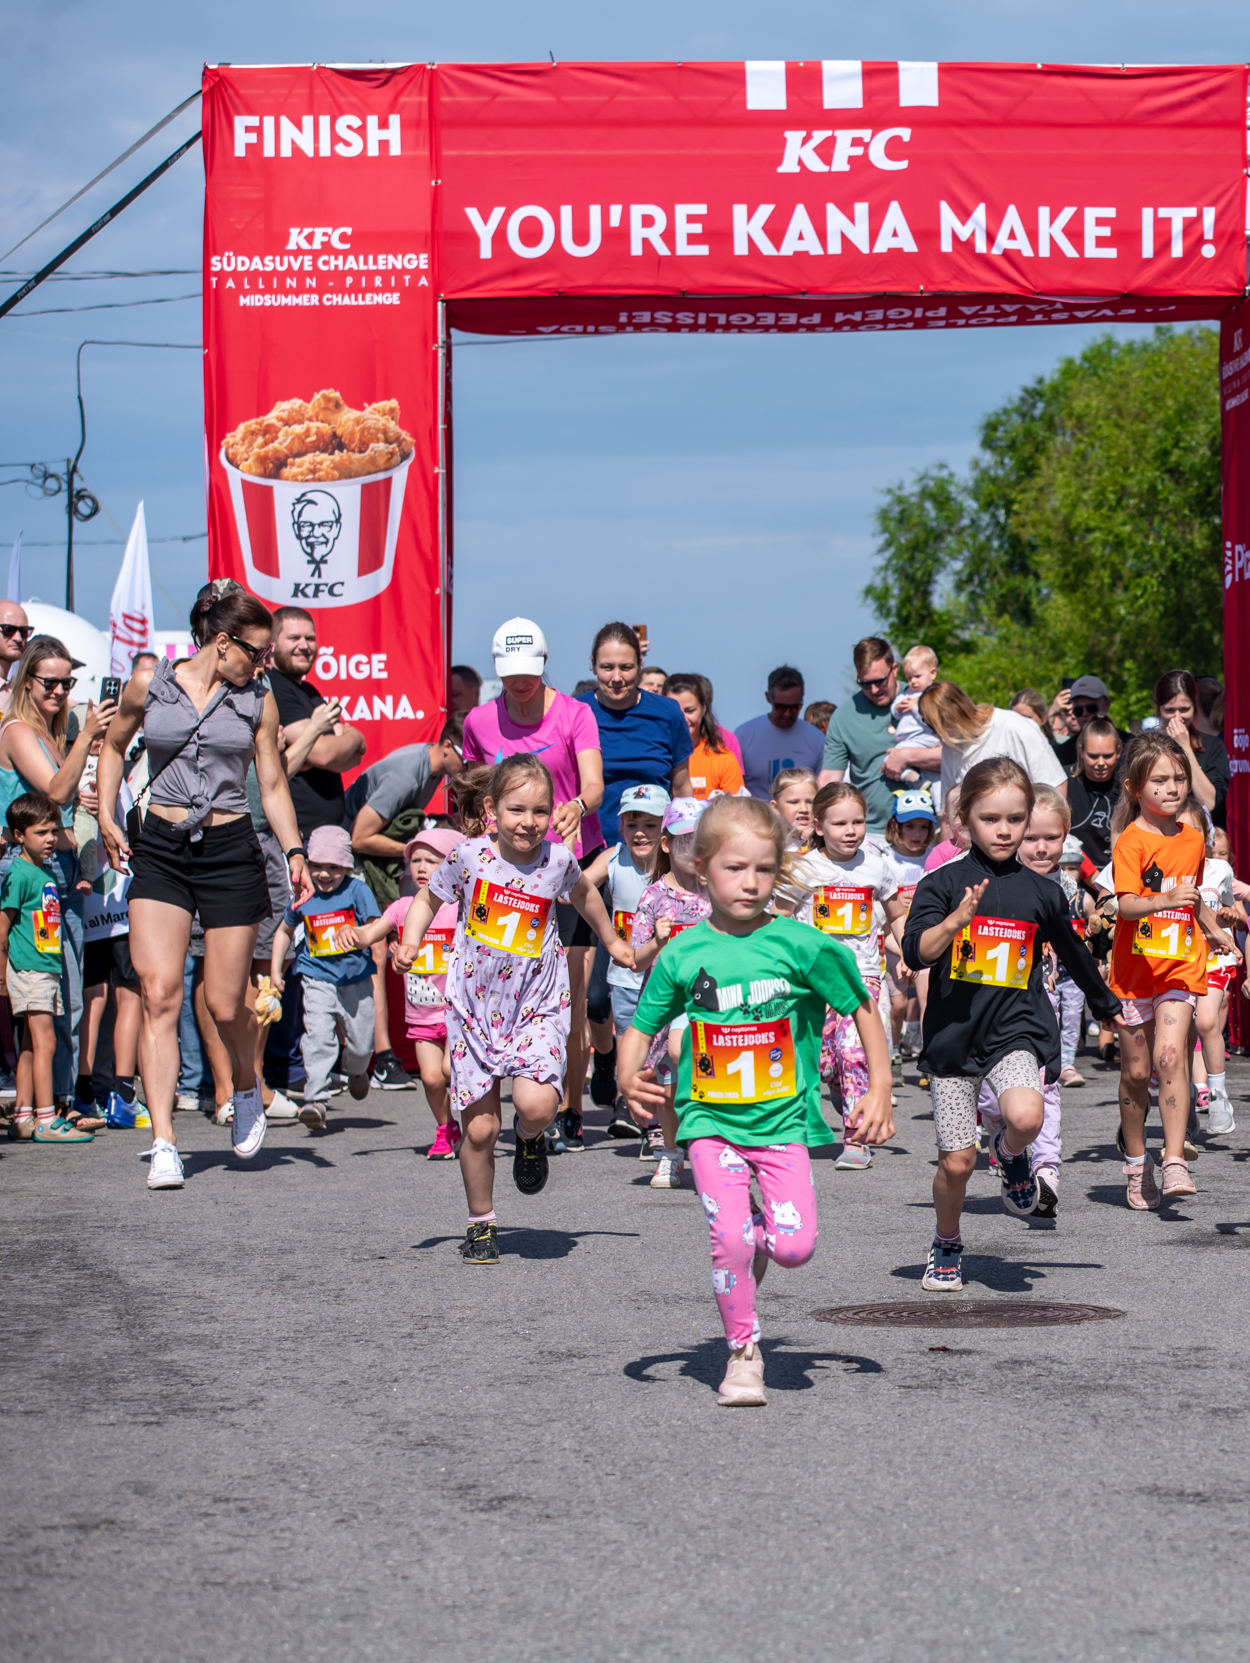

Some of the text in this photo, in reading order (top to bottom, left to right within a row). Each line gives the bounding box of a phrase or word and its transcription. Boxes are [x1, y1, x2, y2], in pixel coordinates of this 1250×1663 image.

[233, 114, 402, 158] FINISH
[776, 126, 912, 173] KFC
[286, 227, 352, 250] KFC
[463, 200, 1216, 259] YOU'RE KANA MAKE IT!
[210, 251, 429, 272] SÜDASUVE CHALLENGE
[210, 277, 317, 289] TALLINN
[346, 275, 429, 288] PIRITA
[239, 292, 401, 307] MIDSUMMER CHALLENGE
[618, 311, 822, 325] PEEGLISSE!
[834, 306, 947, 323] PIGEM
[290, 581, 345, 599] KFC
[506, 636, 533, 645] SUPER
[315, 646, 388, 681] ÕIGE
[492, 892, 540, 914] LASTEJOOKS
[829, 892, 865, 900] LASTEJOOKS
[313, 916, 345, 928] LASTEJOOKS
[836, 902, 853, 931] 1
[322, 926, 338, 952] 1
[496, 911, 521, 948] 1
[977, 925, 1026, 941] LASTEJOOKS
[1161, 922, 1179, 956] 1
[418, 943, 434, 971] 1
[986, 941, 1011, 982] 1
[712, 1031, 775, 1047] LASTEJOOKS
[727, 1051, 755, 1098] 1
